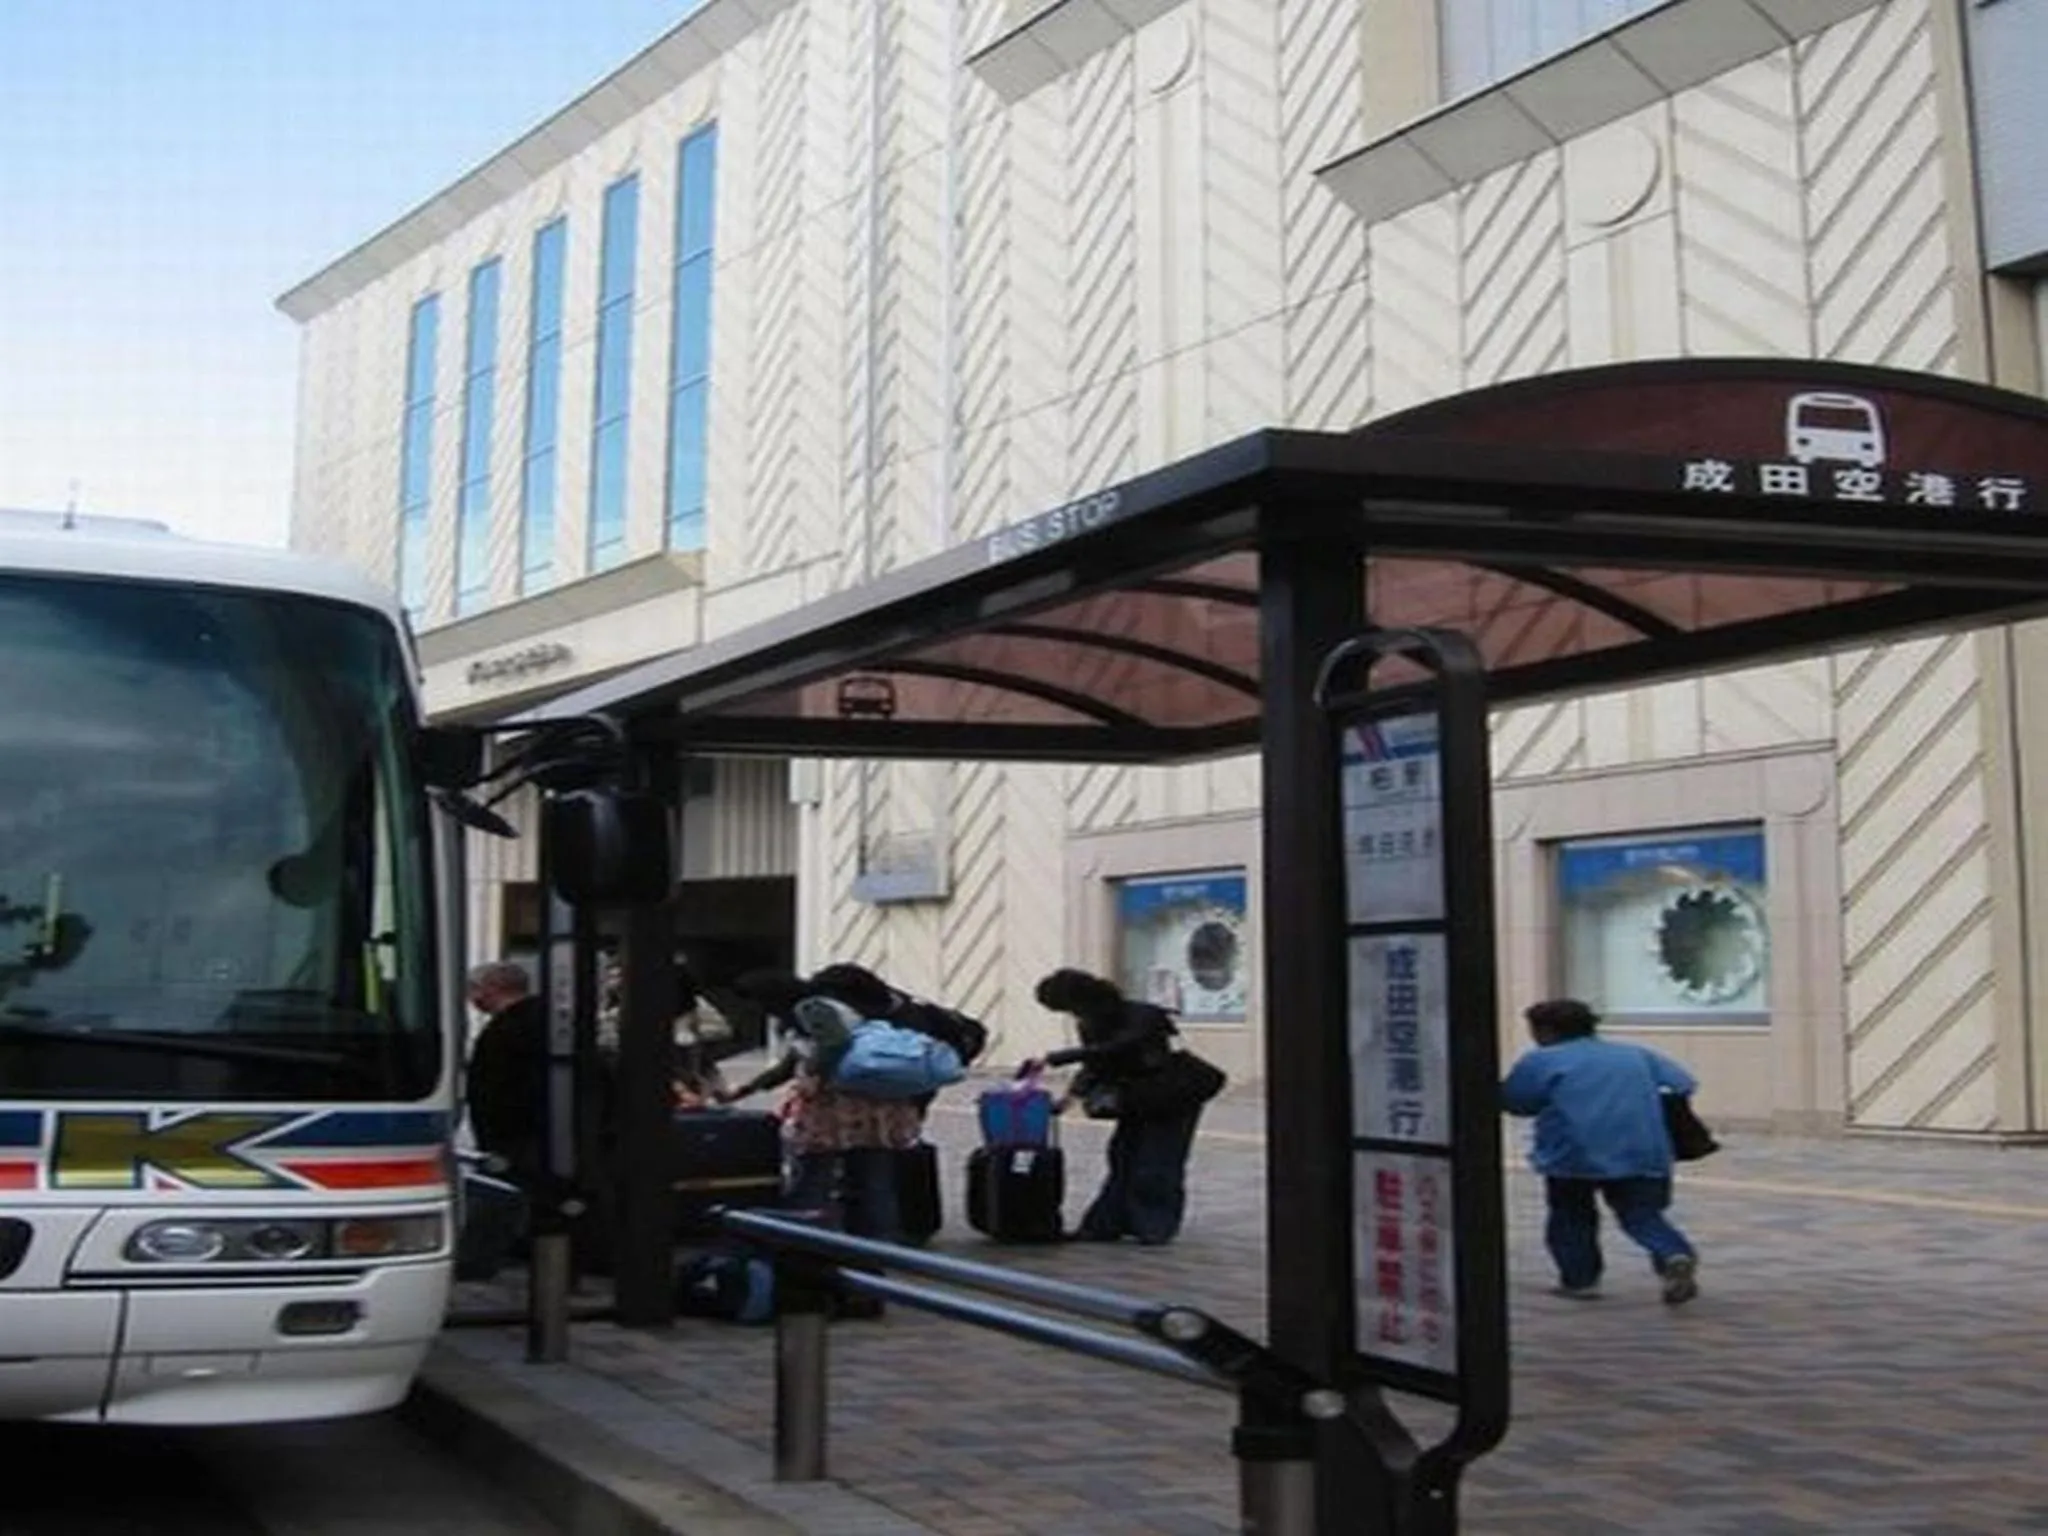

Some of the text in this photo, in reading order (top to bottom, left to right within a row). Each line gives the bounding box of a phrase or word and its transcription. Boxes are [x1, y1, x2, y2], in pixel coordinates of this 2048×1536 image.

[1683, 458, 2027, 511] 成田空港行
[1048, 490, 1122, 541] STOP
[1386, 946, 1424, 1136] 成田空港行
